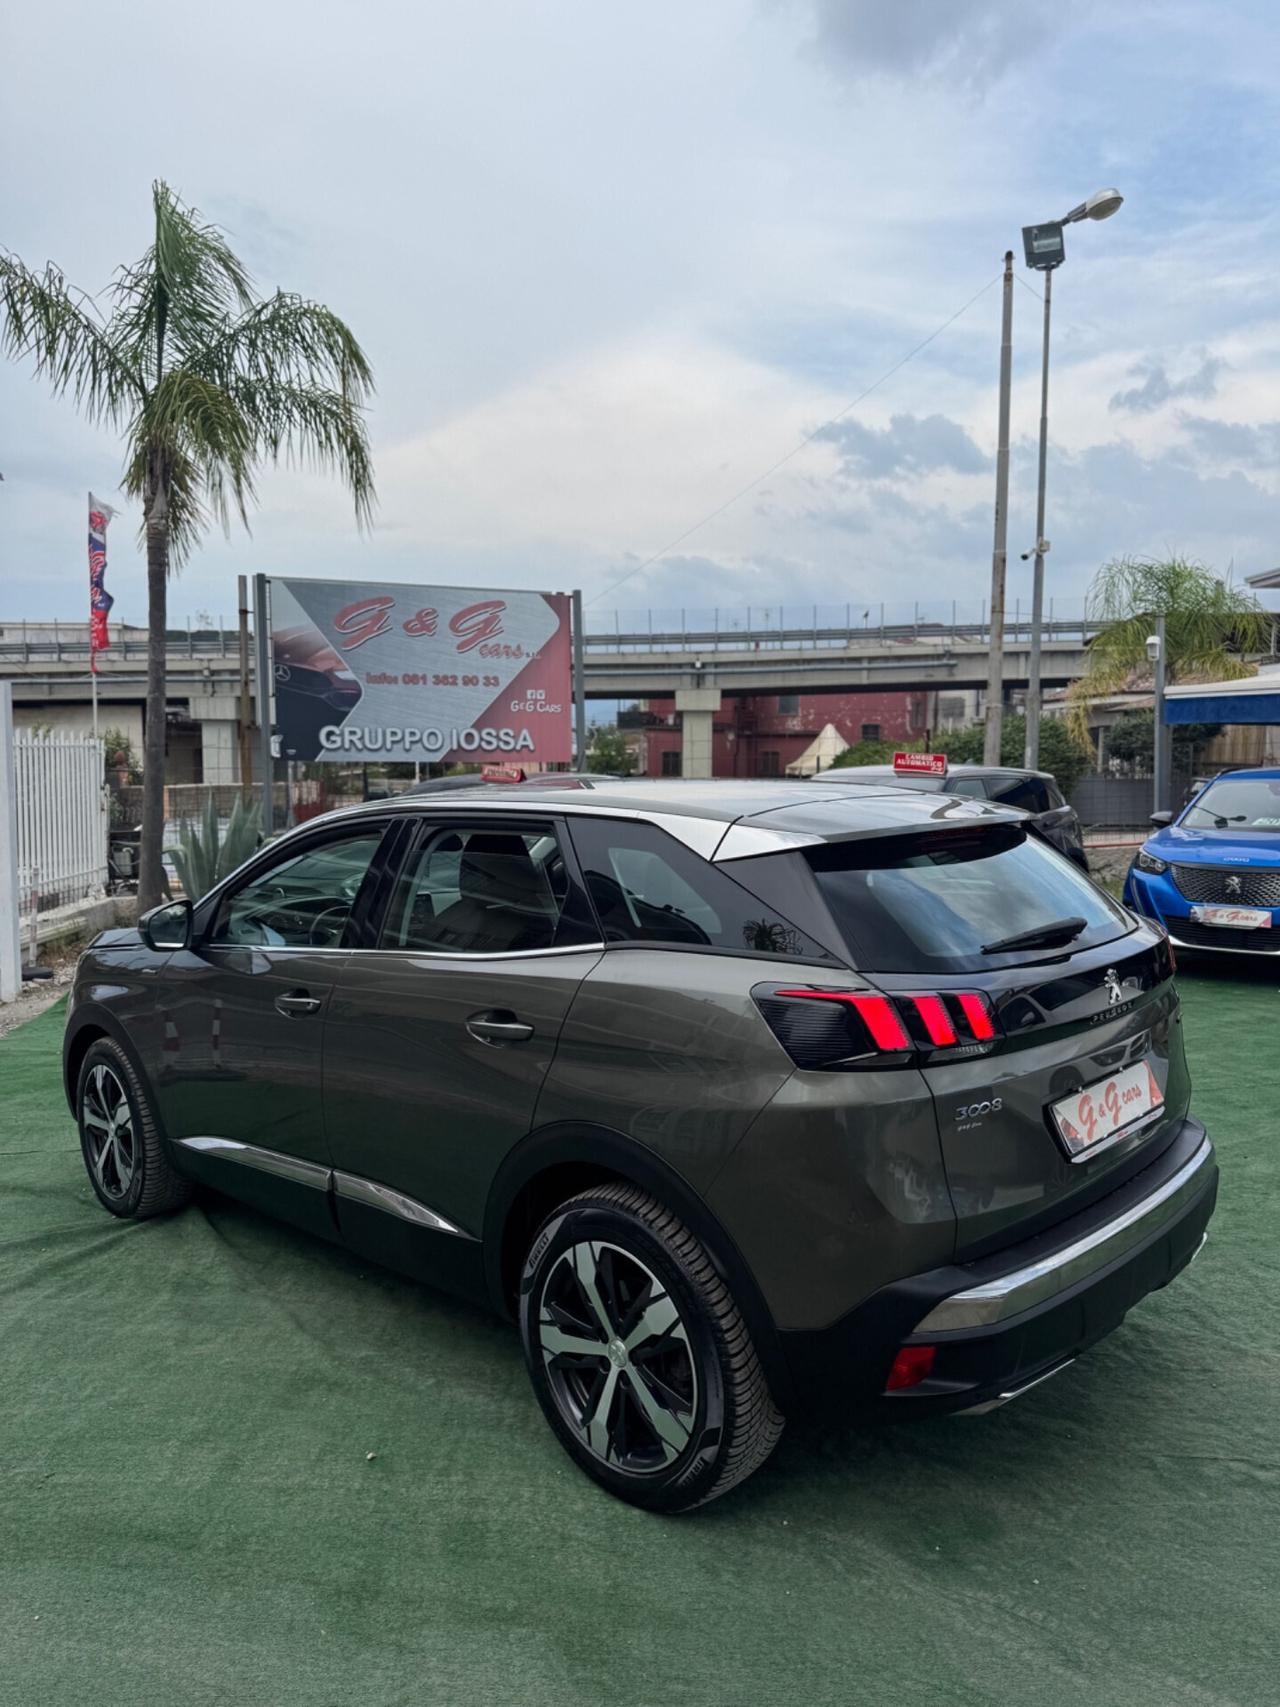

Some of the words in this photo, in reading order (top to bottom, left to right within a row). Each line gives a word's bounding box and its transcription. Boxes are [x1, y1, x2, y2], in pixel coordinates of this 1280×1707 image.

[334, 596, 395, 650] G
[402, 608, 438, 636] &
[448, 600, 506, 653] G
[319, 726, 443, 750] GRUPPO
[452, 728, 535, 751] IOSSA
[955, 1097, 1003, 1121] 3008
[1078, 1094, 1098, 1142] G
[1105, 1081, 1122, 1126] G
